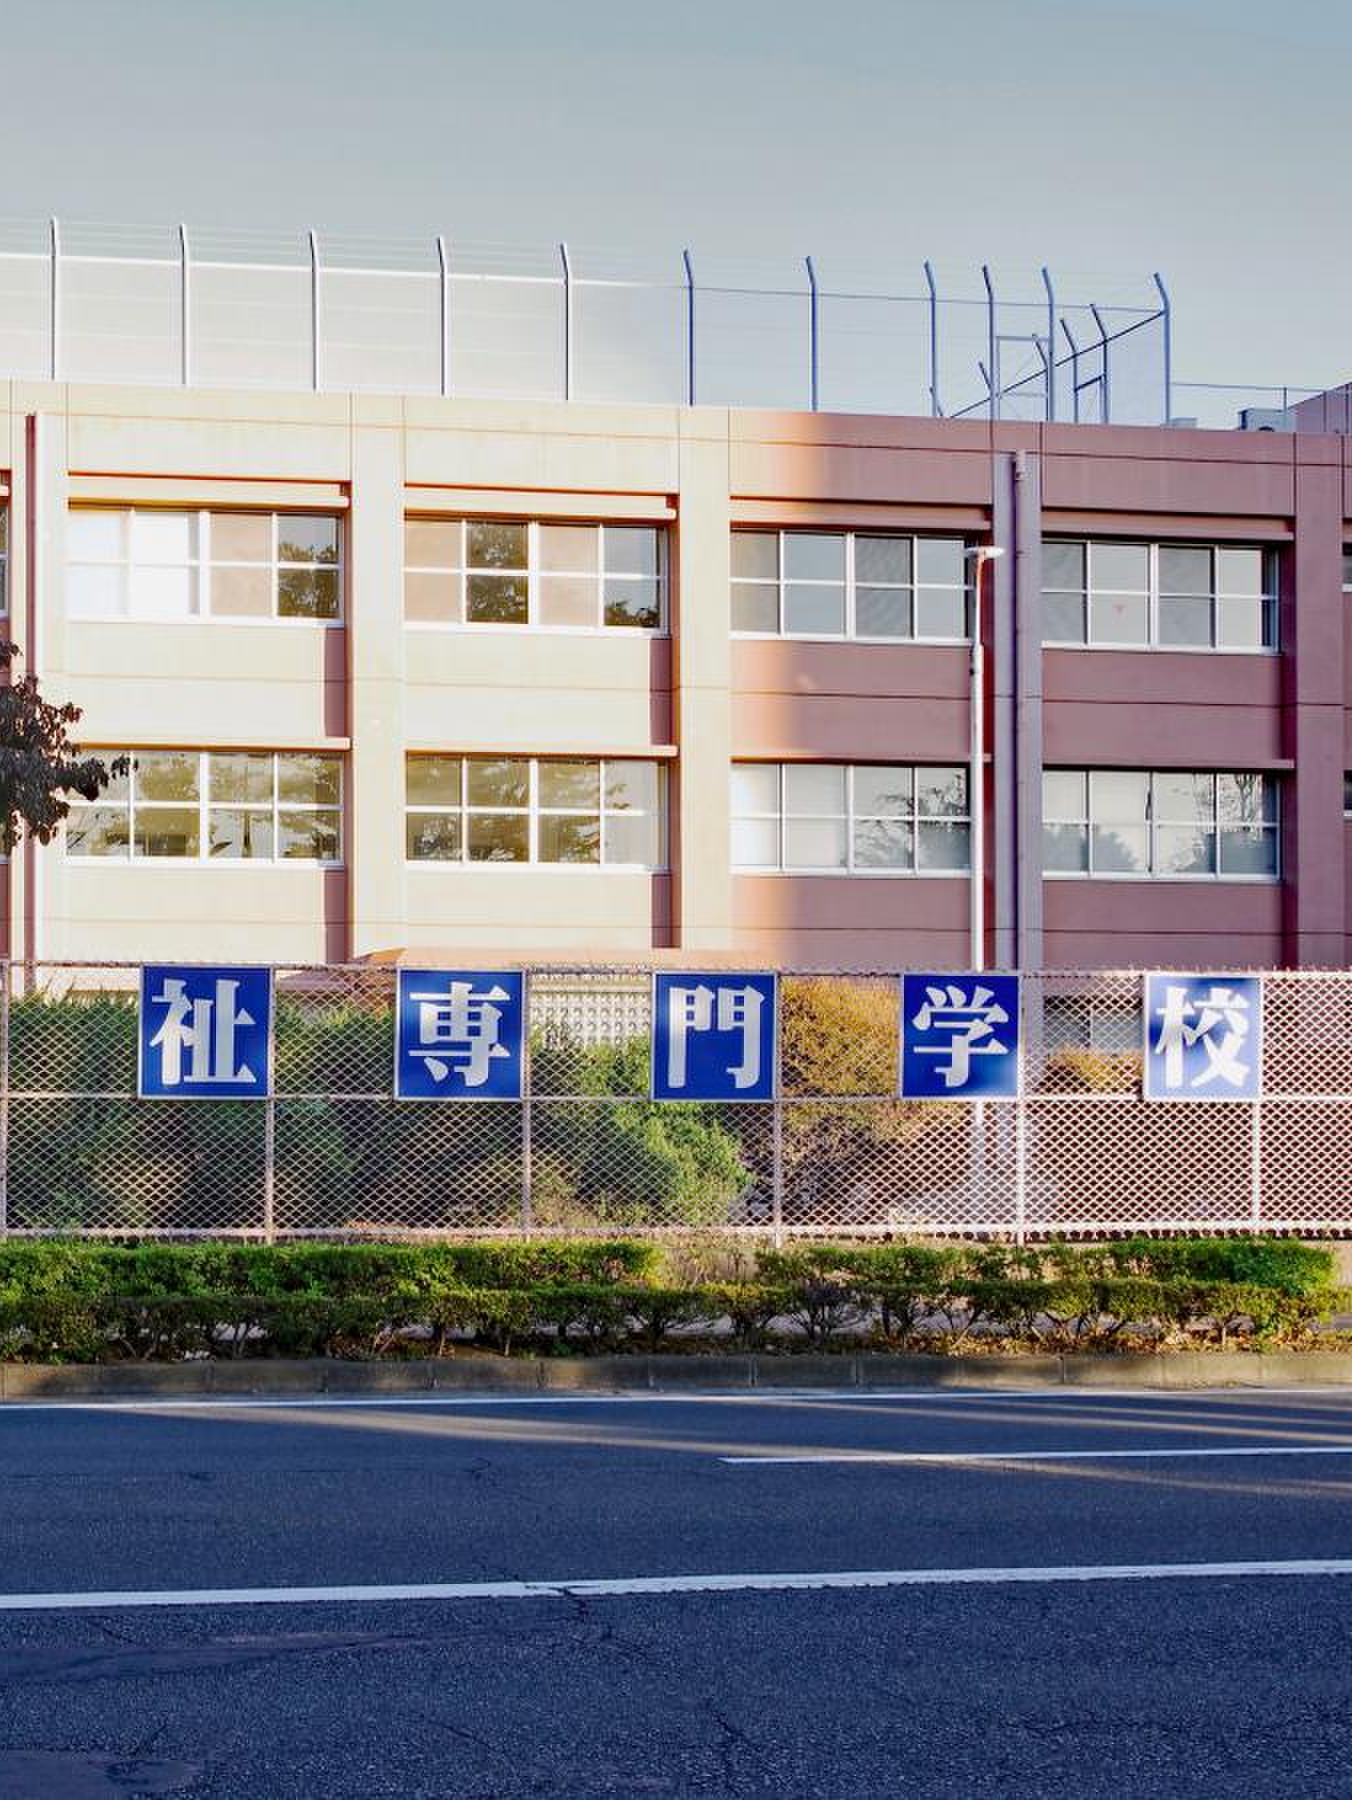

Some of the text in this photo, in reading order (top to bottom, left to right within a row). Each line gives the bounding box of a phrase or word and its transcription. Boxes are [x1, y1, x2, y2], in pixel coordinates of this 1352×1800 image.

[150, 978, 257, 1086] 祉
[408, 981, 511, 1087] 専
[666, 985, 762, 1089] 門
[913, 985, 1008, 1088] 学
[1155, 986, 1250, 1088] 校
